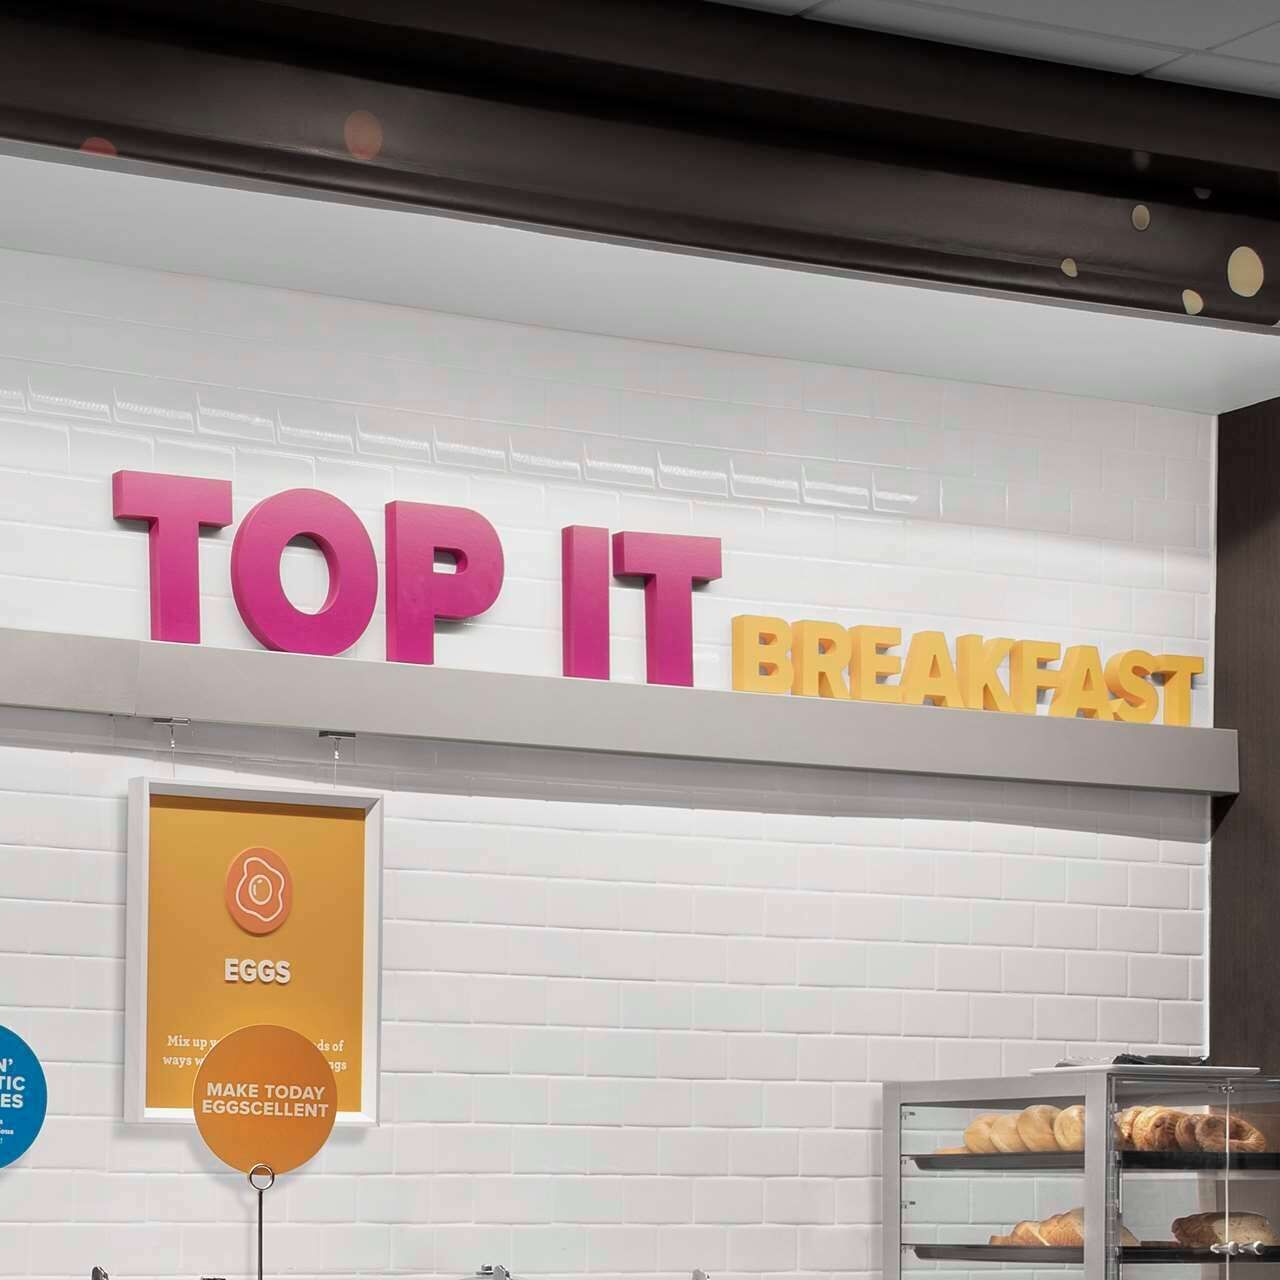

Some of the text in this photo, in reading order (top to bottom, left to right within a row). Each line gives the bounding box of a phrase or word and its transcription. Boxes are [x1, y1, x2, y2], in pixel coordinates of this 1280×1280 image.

[112, 469, 723, 687] TOP IT
[731, 615, 1204, 727] BREAKFAST
[224, 958, 291, 984] EGGS
[167, 1034, 190, 1047] Mix
[192, 1039, 208, 1051] up
[332, 1039, 345, 1052] of
[162, 1056, 192, 1068] ways
[207, 1082, 326, 1100] MAKE TODAY
[202, 1099, 329, 1118] EGGSCELLENT
